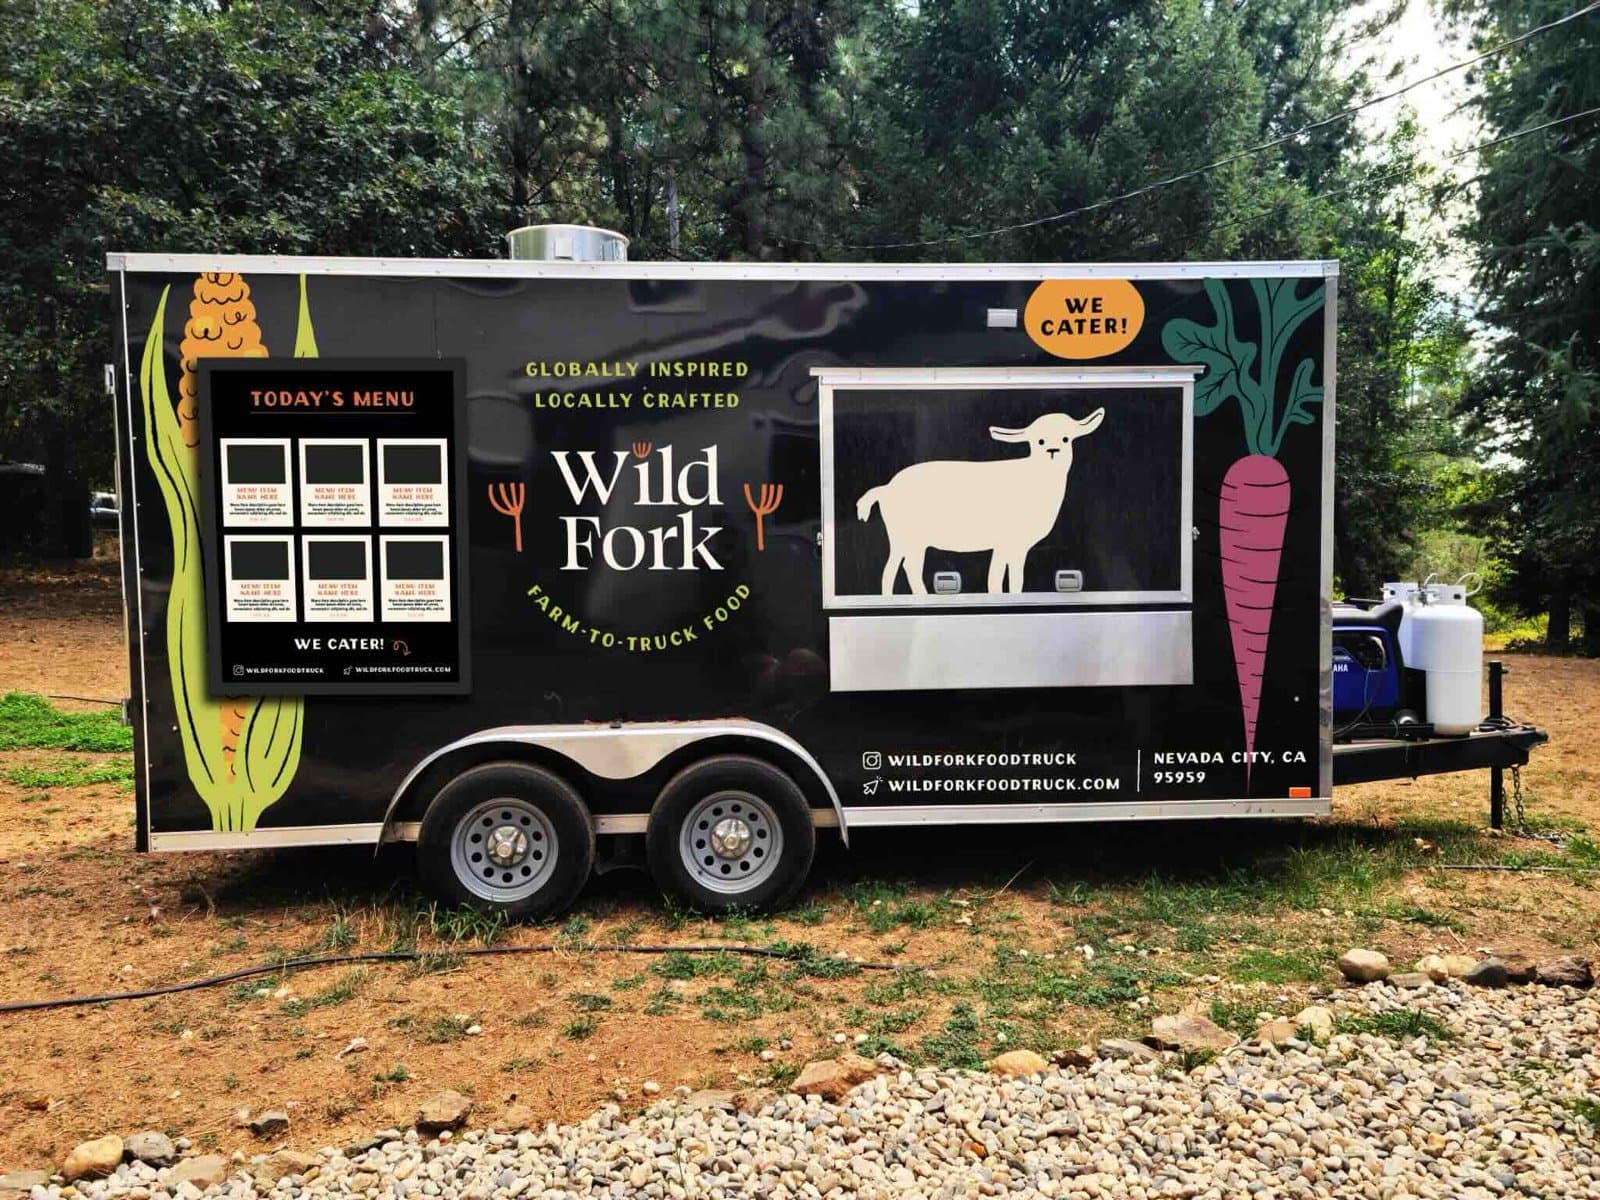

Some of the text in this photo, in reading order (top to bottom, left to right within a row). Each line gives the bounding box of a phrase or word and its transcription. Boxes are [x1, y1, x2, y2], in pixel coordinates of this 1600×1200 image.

[1064, 297, 1103, 314] WE
[1040, 318, 1127, 336] CATER!
[525, 361, 748, 377] GLOBALLY INSPIRED
[250, 390, 414, 407] TODAY'S MENU
[535, 392, 739, 408] LOCALLY CRAFTED
[550, 442, 724, 506] Wild
[559, 510, 724, 571] Fork
[527, 584, 750, 651] FARM-TO-TRUCK FOOD
[294, 638, 385, 650] WE CATER!
[888, 752, 1076, 767] WILDFORKFOODTRUCK
[1154, 751, 1307, 765] NEVADA CITY, CA
[1153, 770, 1206, 784] 95959
[888, 778, 1121, 793] WILDFORKFOODTRUCK.COM
